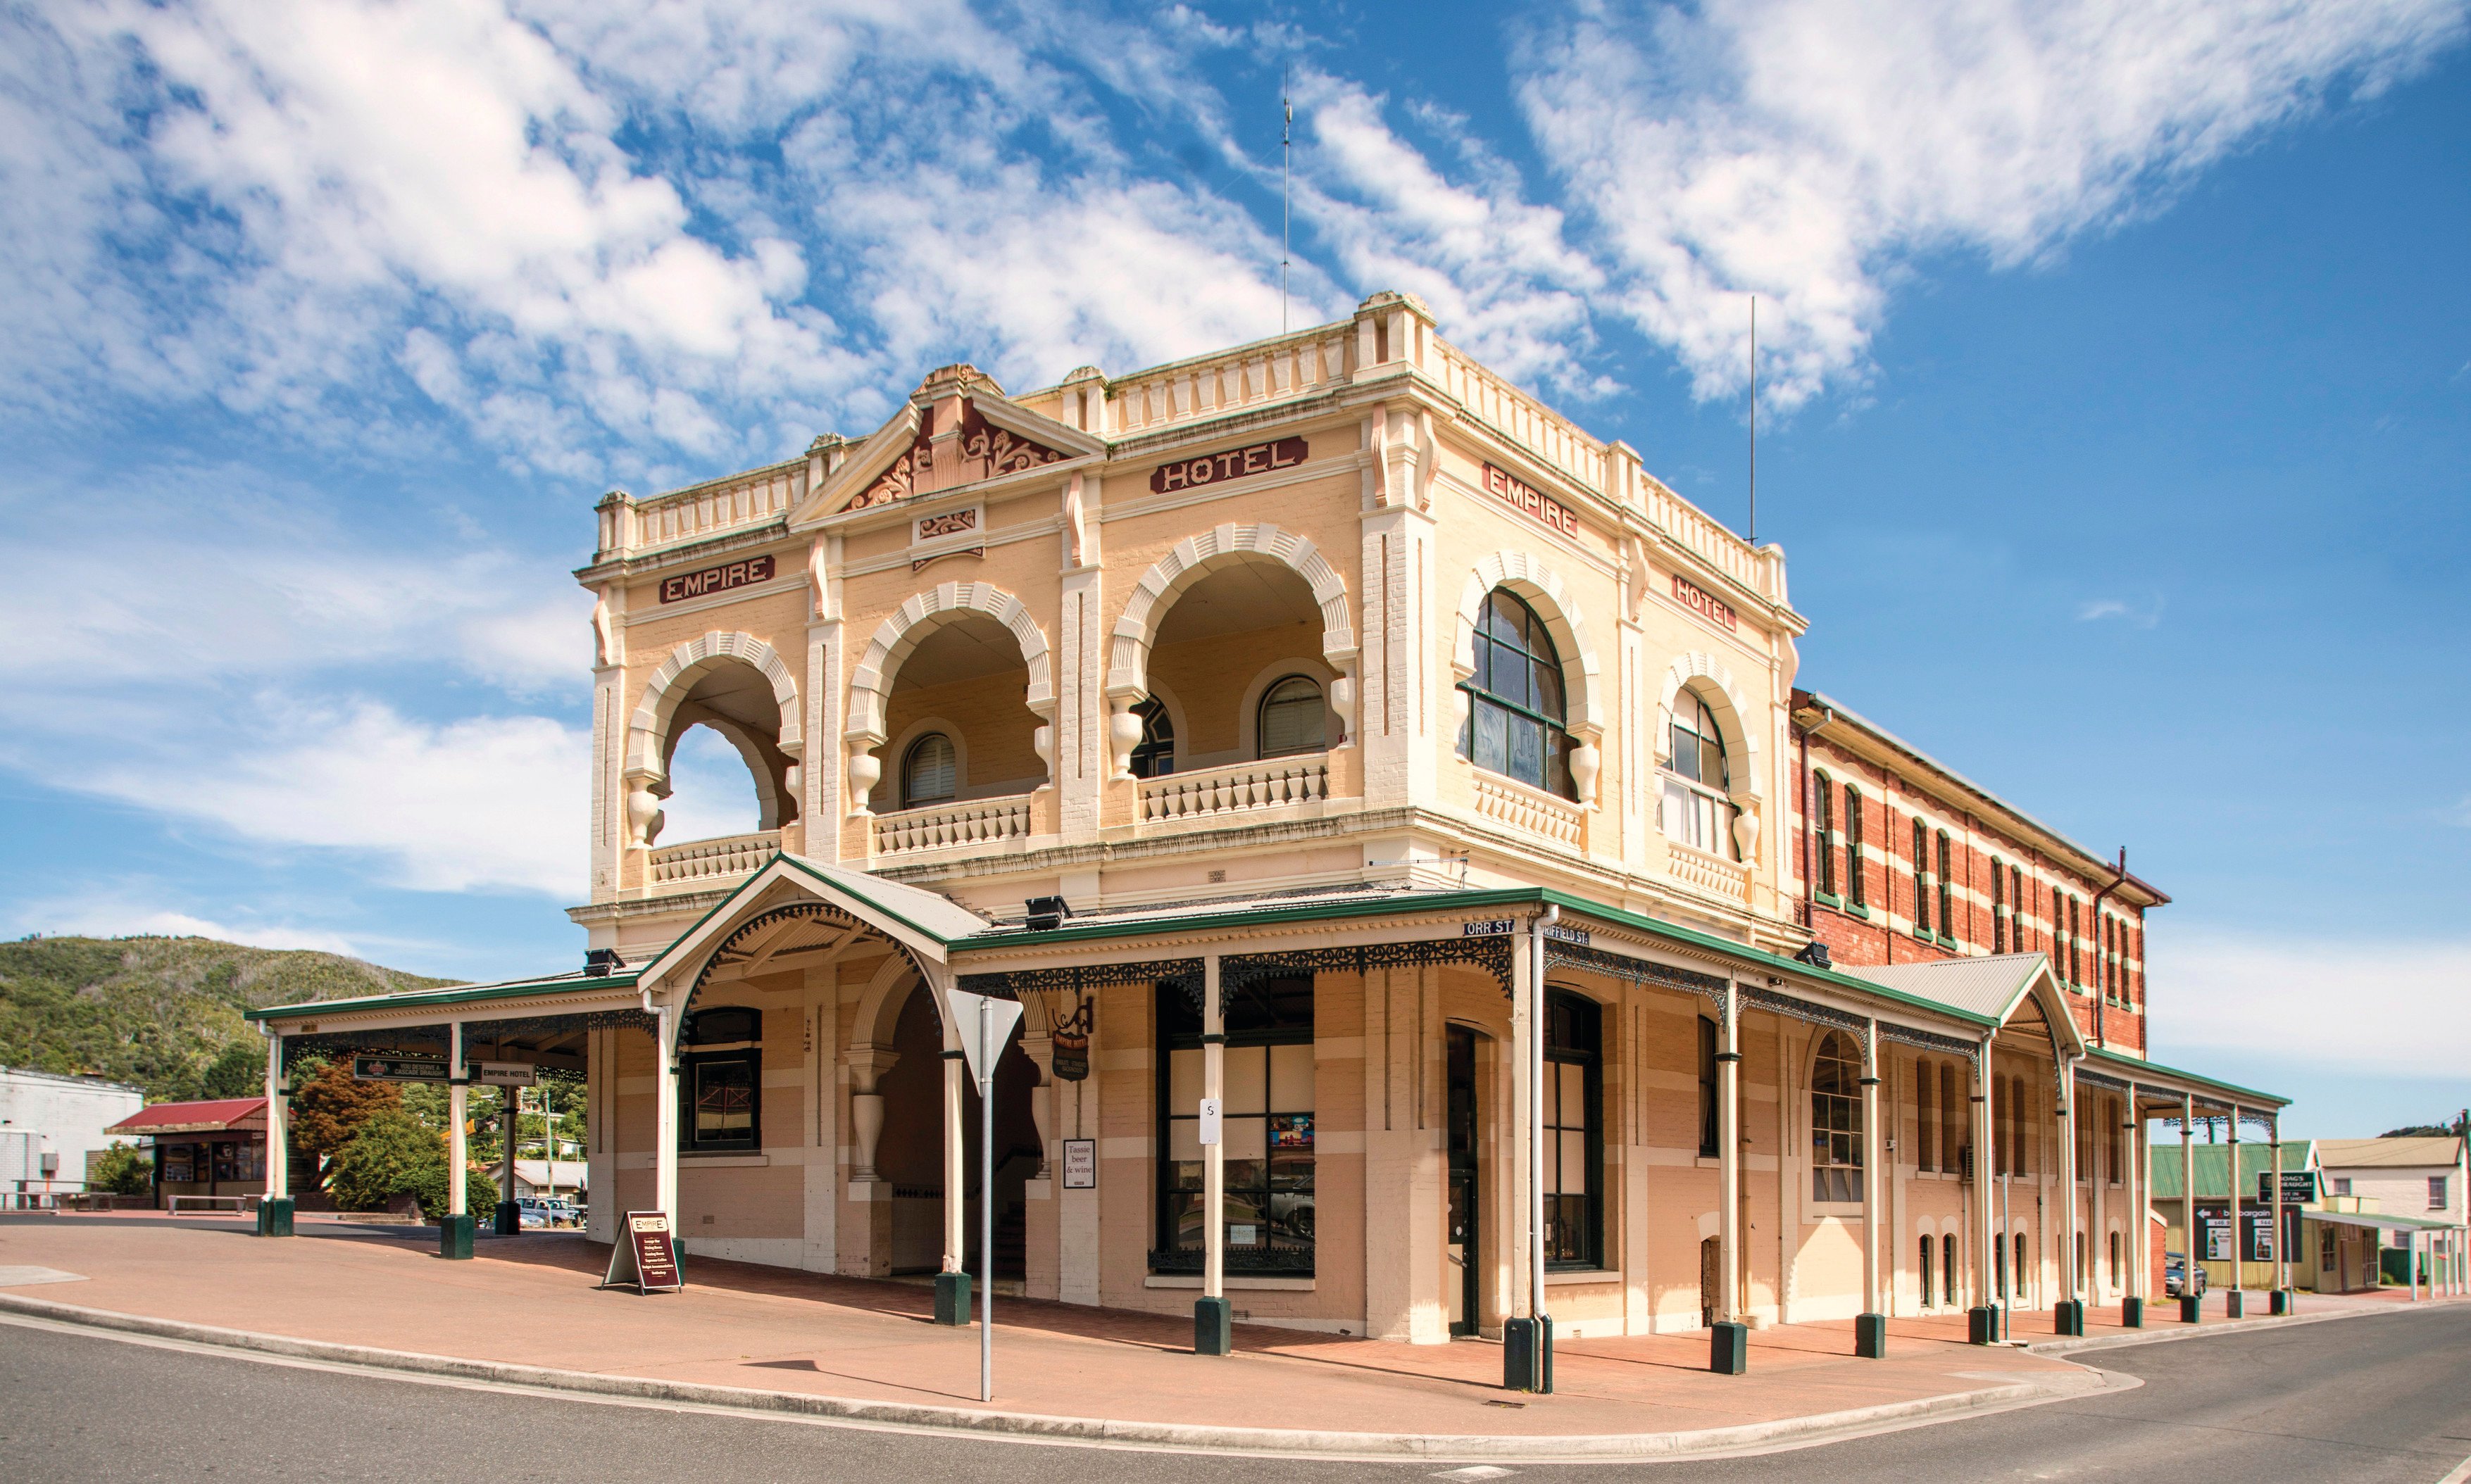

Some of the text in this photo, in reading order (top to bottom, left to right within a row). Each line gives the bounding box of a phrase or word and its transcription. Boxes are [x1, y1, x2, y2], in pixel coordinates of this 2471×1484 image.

[1163, 442, 1296, 491] HOTEL
[1489, 465, 1577, 540] EMPIRE
[666, 557, 767, 601] EMPIRE
[1677, 577, 1735, 631] HOTEL
[1467, 923, 1491, 935] ORR
[1068, 1145, 1091, 1154] Tassie
[1071, 1155, 1087, 1163] beer
[1075, 1165, 1092, 1174] wine
[635, 1220, 663, 1229] EMPIRE
